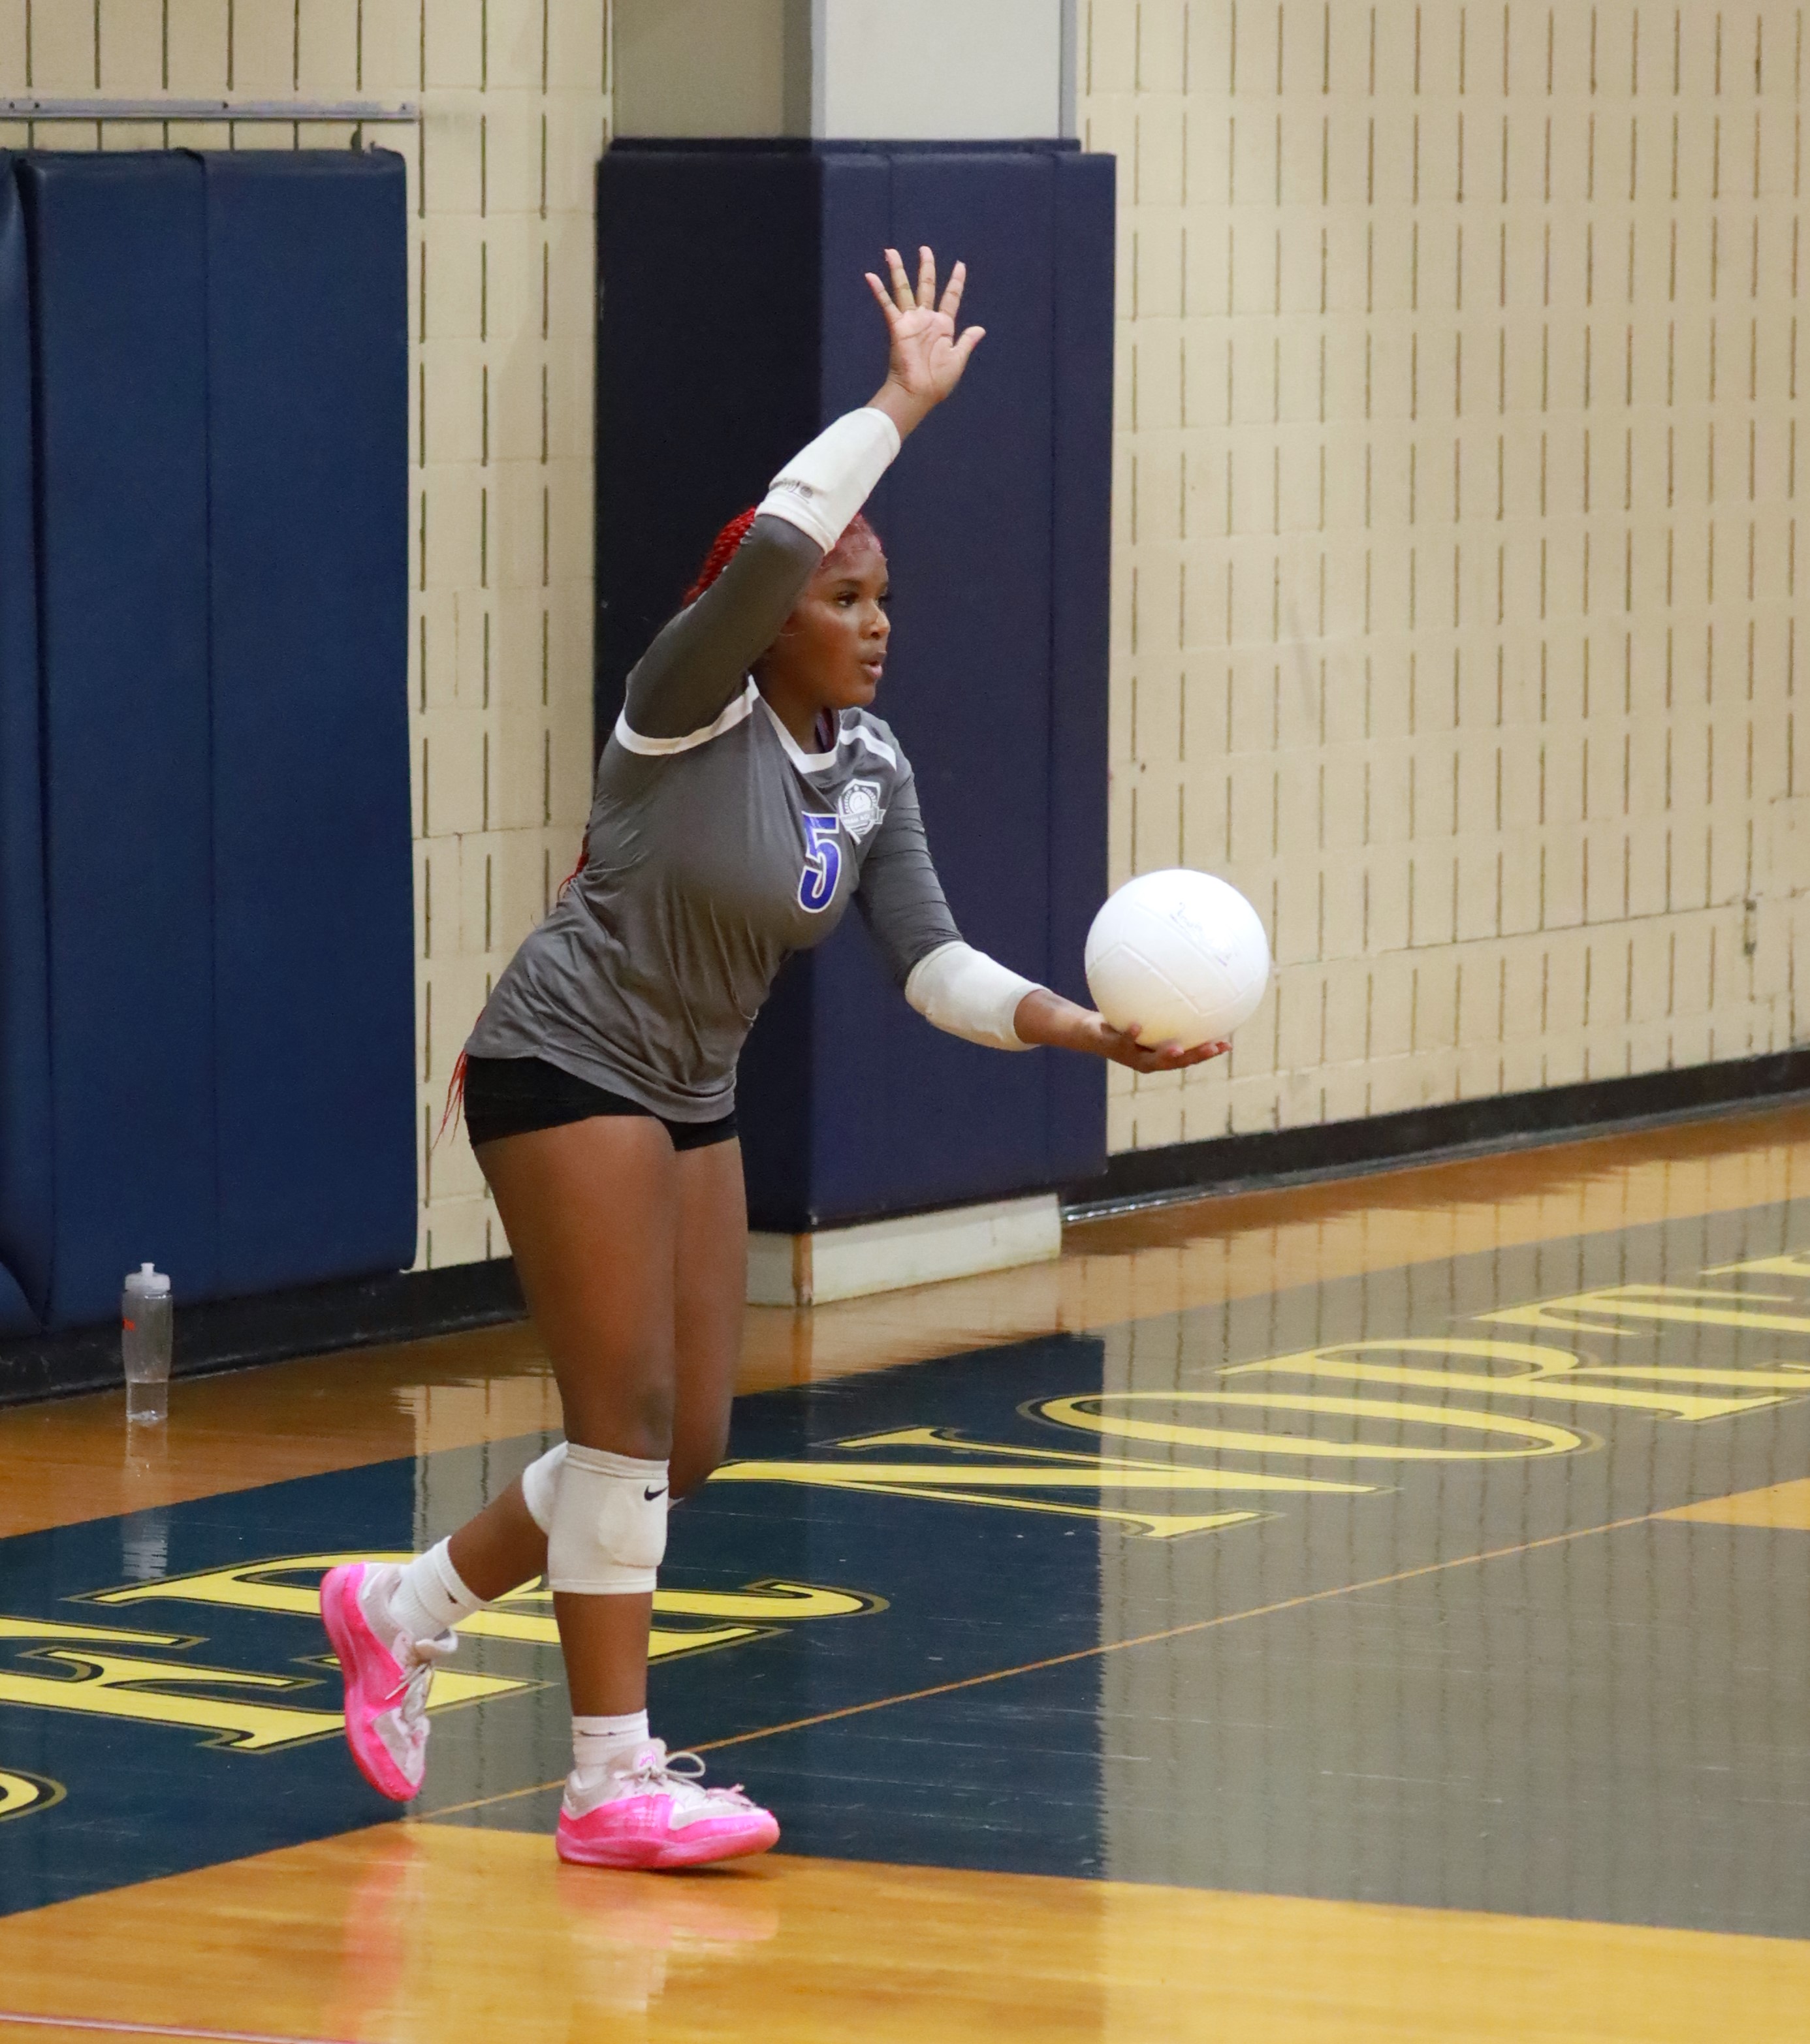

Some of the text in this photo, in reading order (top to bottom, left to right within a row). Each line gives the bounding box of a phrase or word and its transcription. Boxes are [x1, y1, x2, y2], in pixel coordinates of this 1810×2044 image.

[798, 811, 842, 913] 5
[0, 1250, 1810, 1818] ER NORT
